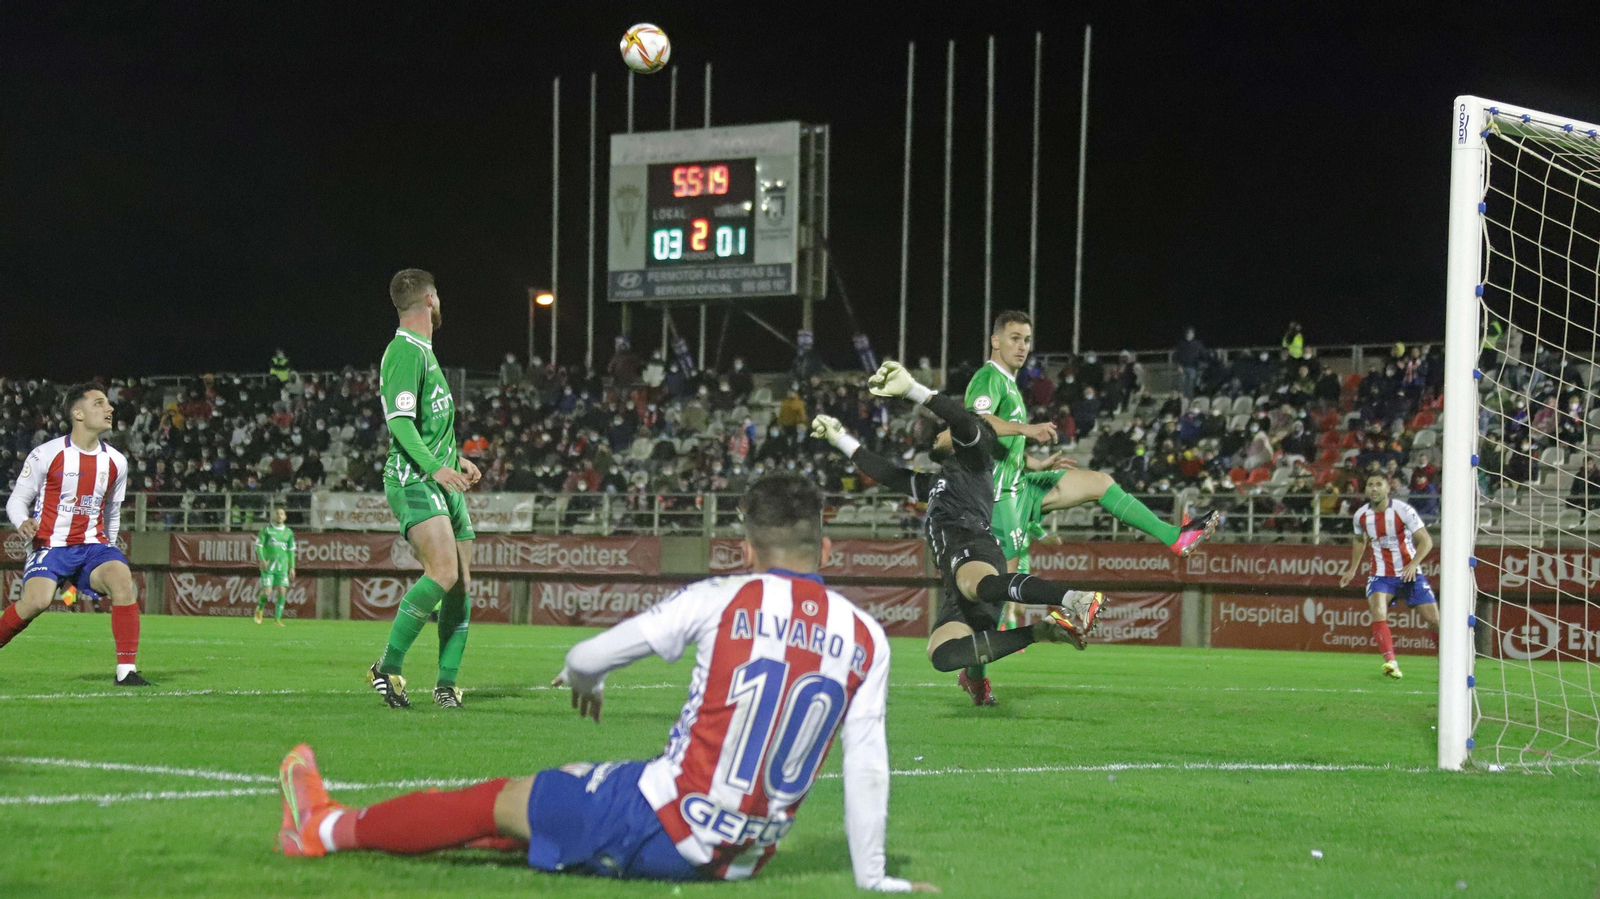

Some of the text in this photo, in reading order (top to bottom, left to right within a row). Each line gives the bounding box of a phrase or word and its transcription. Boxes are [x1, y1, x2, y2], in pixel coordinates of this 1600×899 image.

[673, 166, 729, 197] 55:19
[653, 229, 682, 260] 03
[716, 225, 746, 257] 01
[691, 219, 708, 251] 2
[26, 550, 49, 570] 27
[199, 540, 248, 562] PRIMERA
[297, 540, 370, 562] Footters
[548, 543, 629, 566] Footters
[1098, 555, 1170, 570] PODOLOGÍA
[1220, 602, 1429, 632] Hospital quirósalu
[731, 607, 844, 660] ALVARO
[1323, 632, 1368, 648] Campo
[727, 657, 848, 804] 10
